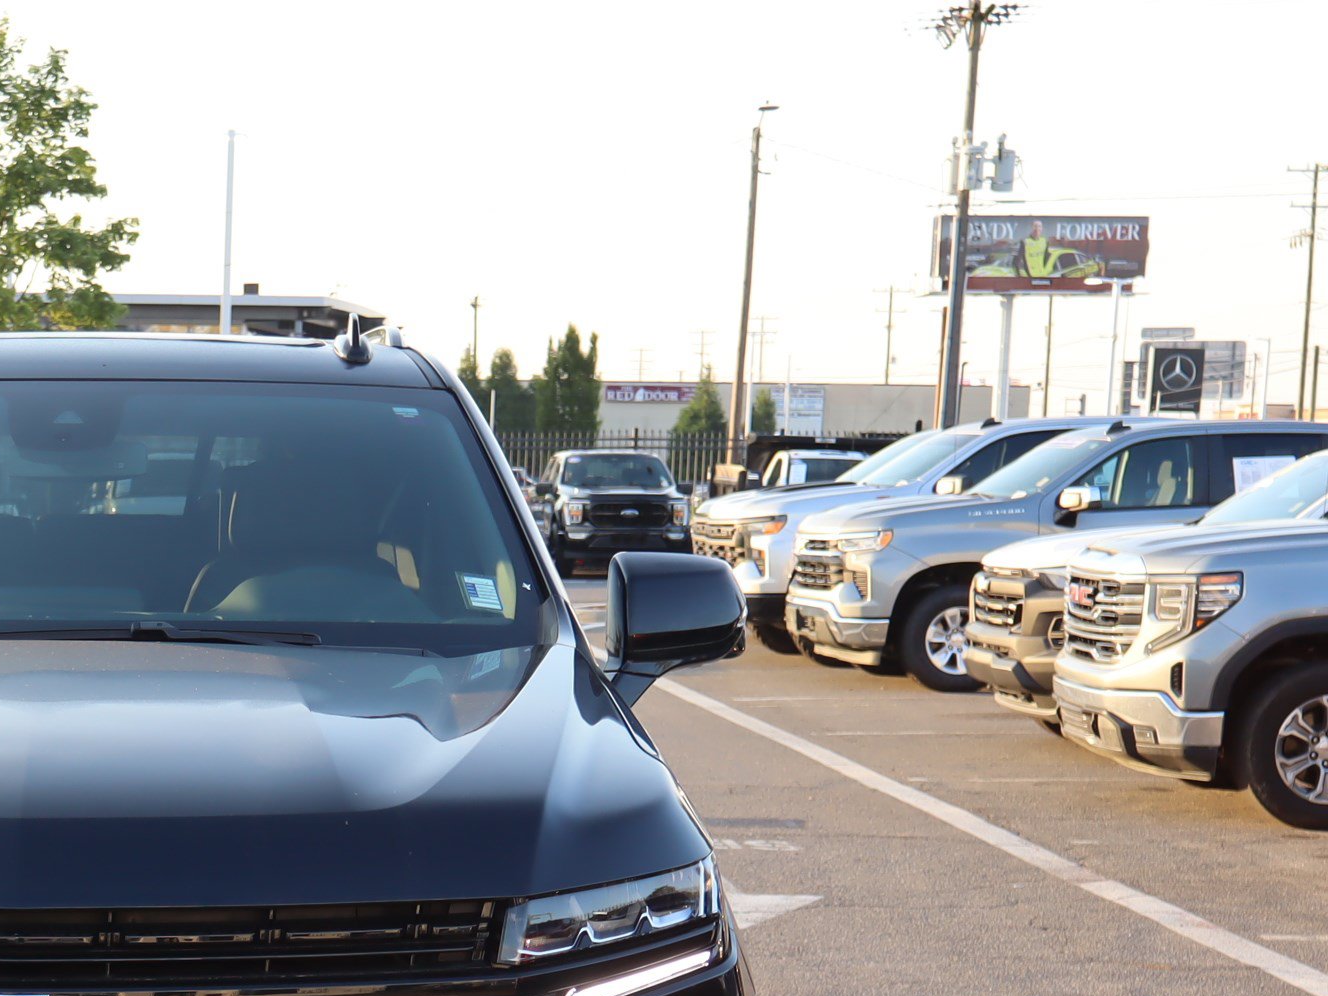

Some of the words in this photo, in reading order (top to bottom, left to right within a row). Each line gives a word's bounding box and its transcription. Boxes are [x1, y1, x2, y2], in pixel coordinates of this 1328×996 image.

[1056, 221, 1140, 241] FOREVER
[607, 389, 633, 402] RED
[645, 390, 679, 402] DOOR
